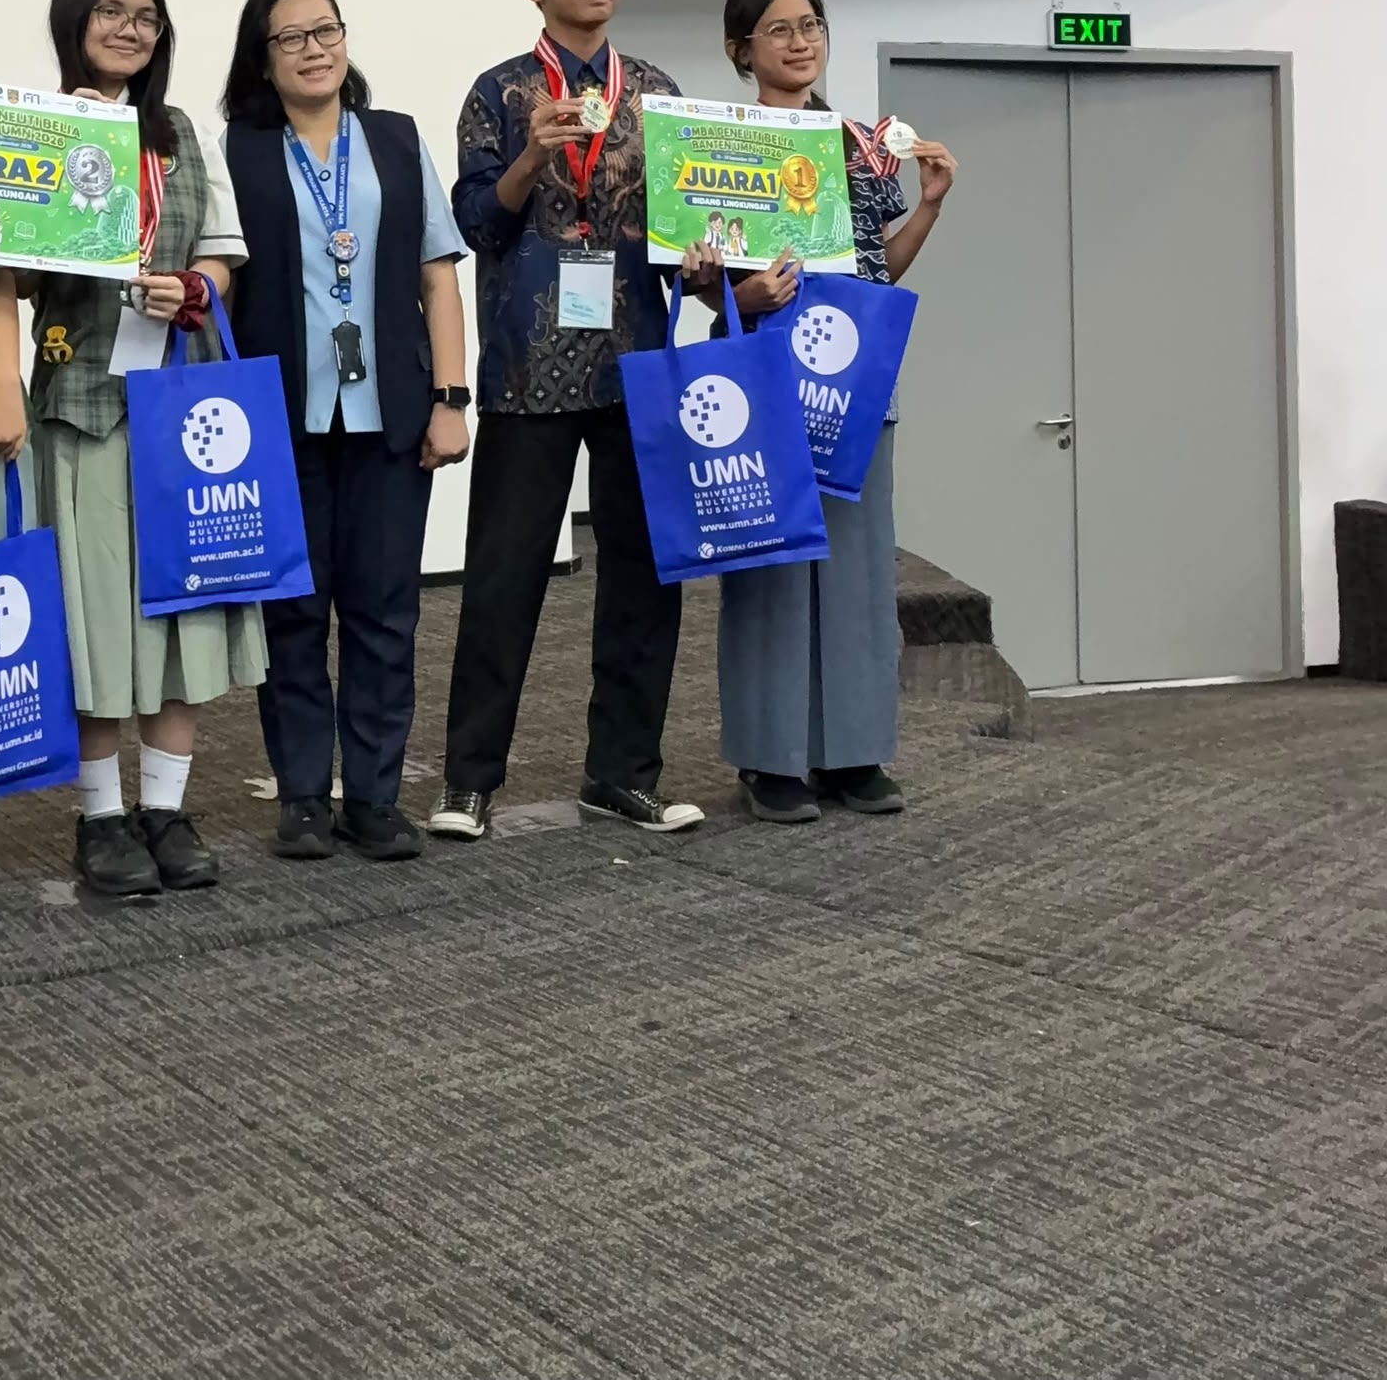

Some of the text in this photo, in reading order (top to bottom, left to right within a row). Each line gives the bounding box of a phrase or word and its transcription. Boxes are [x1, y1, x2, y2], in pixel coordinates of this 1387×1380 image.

[1060, 19, 1122, 42] EXIT
[1, 124, 32, 138] UMN
[33, 129, 66, 147] 2026
[42, 114, 81, 138] BELIA
[717, 128, 764, 143] PENELITI
[765, 133, 796, 148] BELIA
[692, 140, 783, 158] BANTEN UMN 2026
[36, 160, 57, 186] 2
[81, 162, 100, 185] 2
[684, 166, 776, 194] JUARA 1
[793, 166, 804, 188] 1
[692, 197, 771, 211] BIDANG LINGKUNGAN
[803, 410, 844, 426] ERSITAS
[804, 419, 841, 433] IMEDIA
[688, 450, 766, 488] UMN
[187, 479, 260, 516] UMN
[694, 481, 769, 500] UNIVERSITAS
[695, 490, 771, 508] MULTIMEDIA
[697, 498, 772, 516] NUSANTARA
[188, 511, 262, 529] UNIVERSITAS
[189, 520, 263, 537] MULTIMEDIA
[700, 512, 776, 533] www.umn.ac.id
[189, 529, 264, 546] NUSANTARA
[190, 544, 265, 563] www.umn.ac.id
